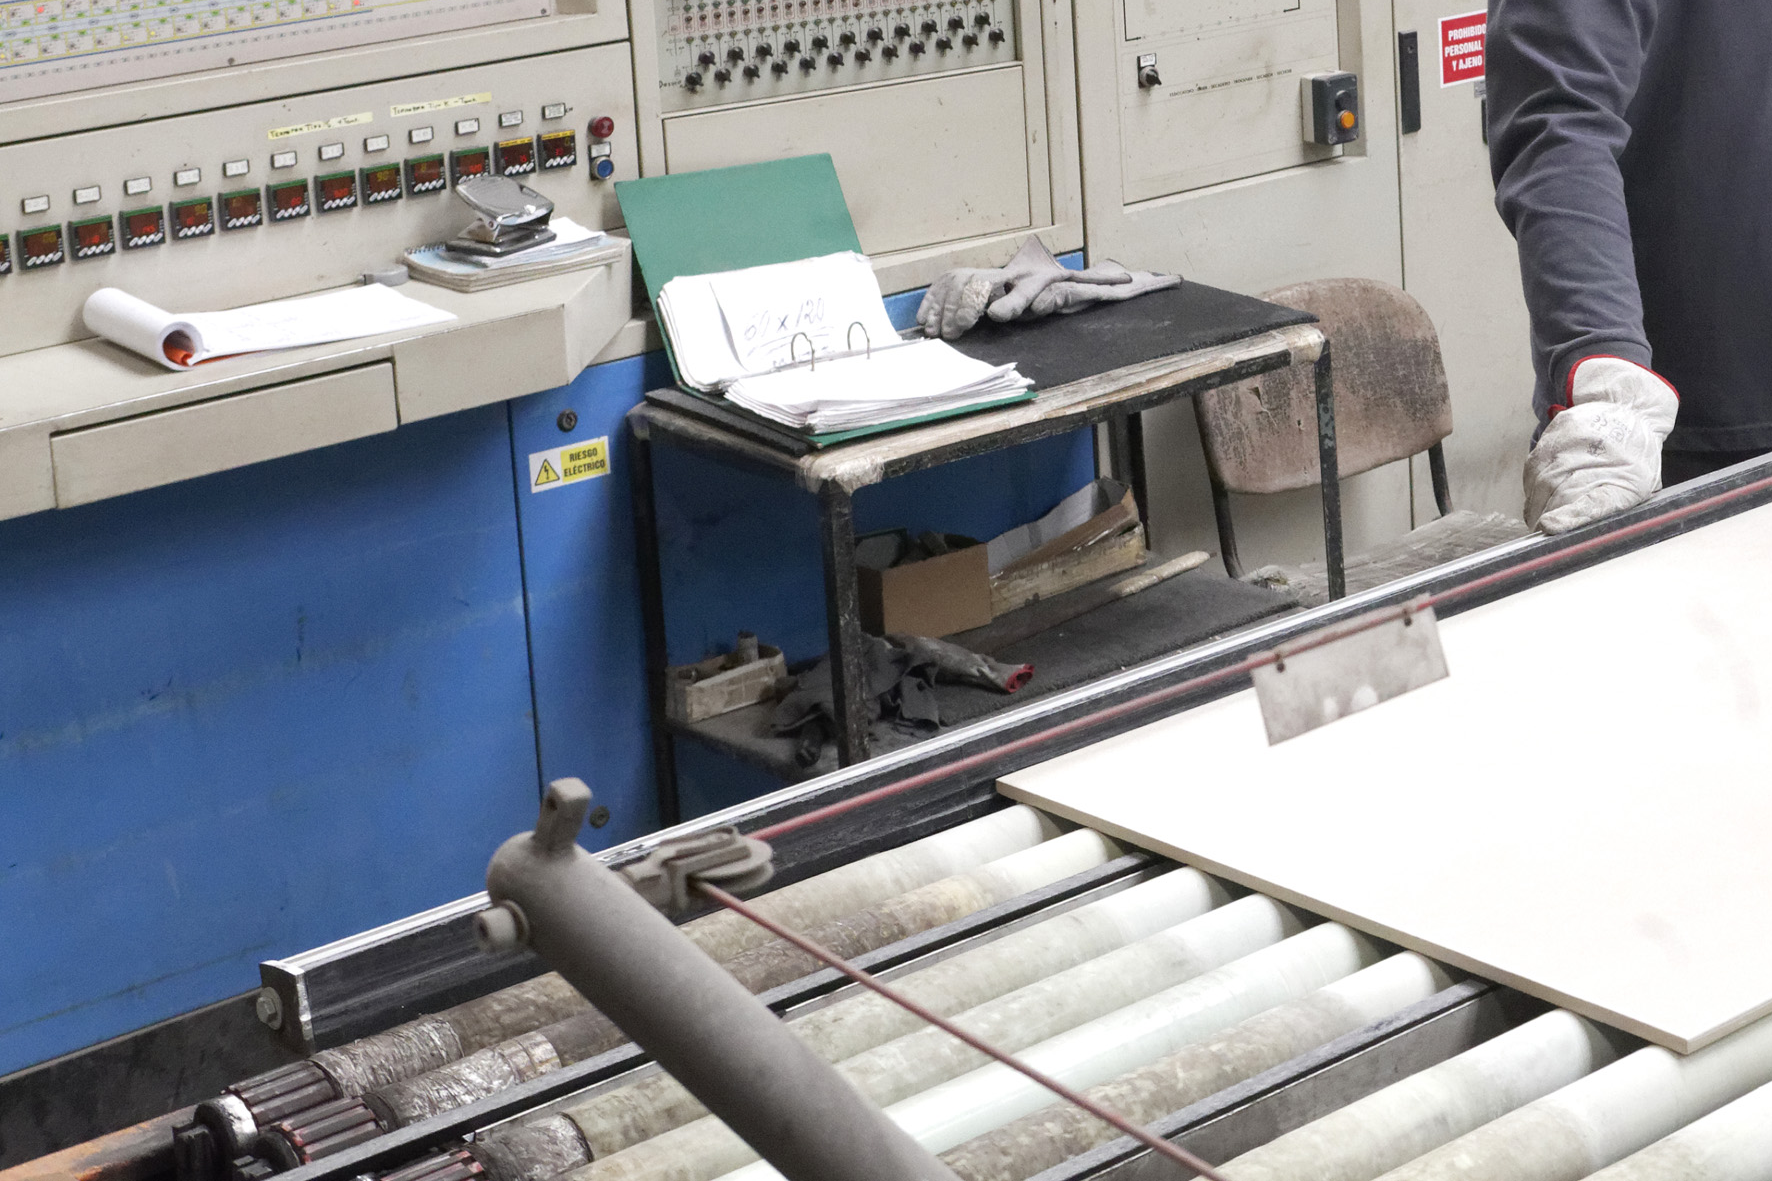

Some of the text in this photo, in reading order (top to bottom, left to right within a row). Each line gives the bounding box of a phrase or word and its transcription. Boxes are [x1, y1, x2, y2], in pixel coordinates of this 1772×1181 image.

[1448, 23, 1487, 42] PROHIBIDO
[1444, 40, 1483, 58] PERSONAL
[1452, 55, 1483, 72] Y AJENO
[569, 447, 598, 463] RIESGO
